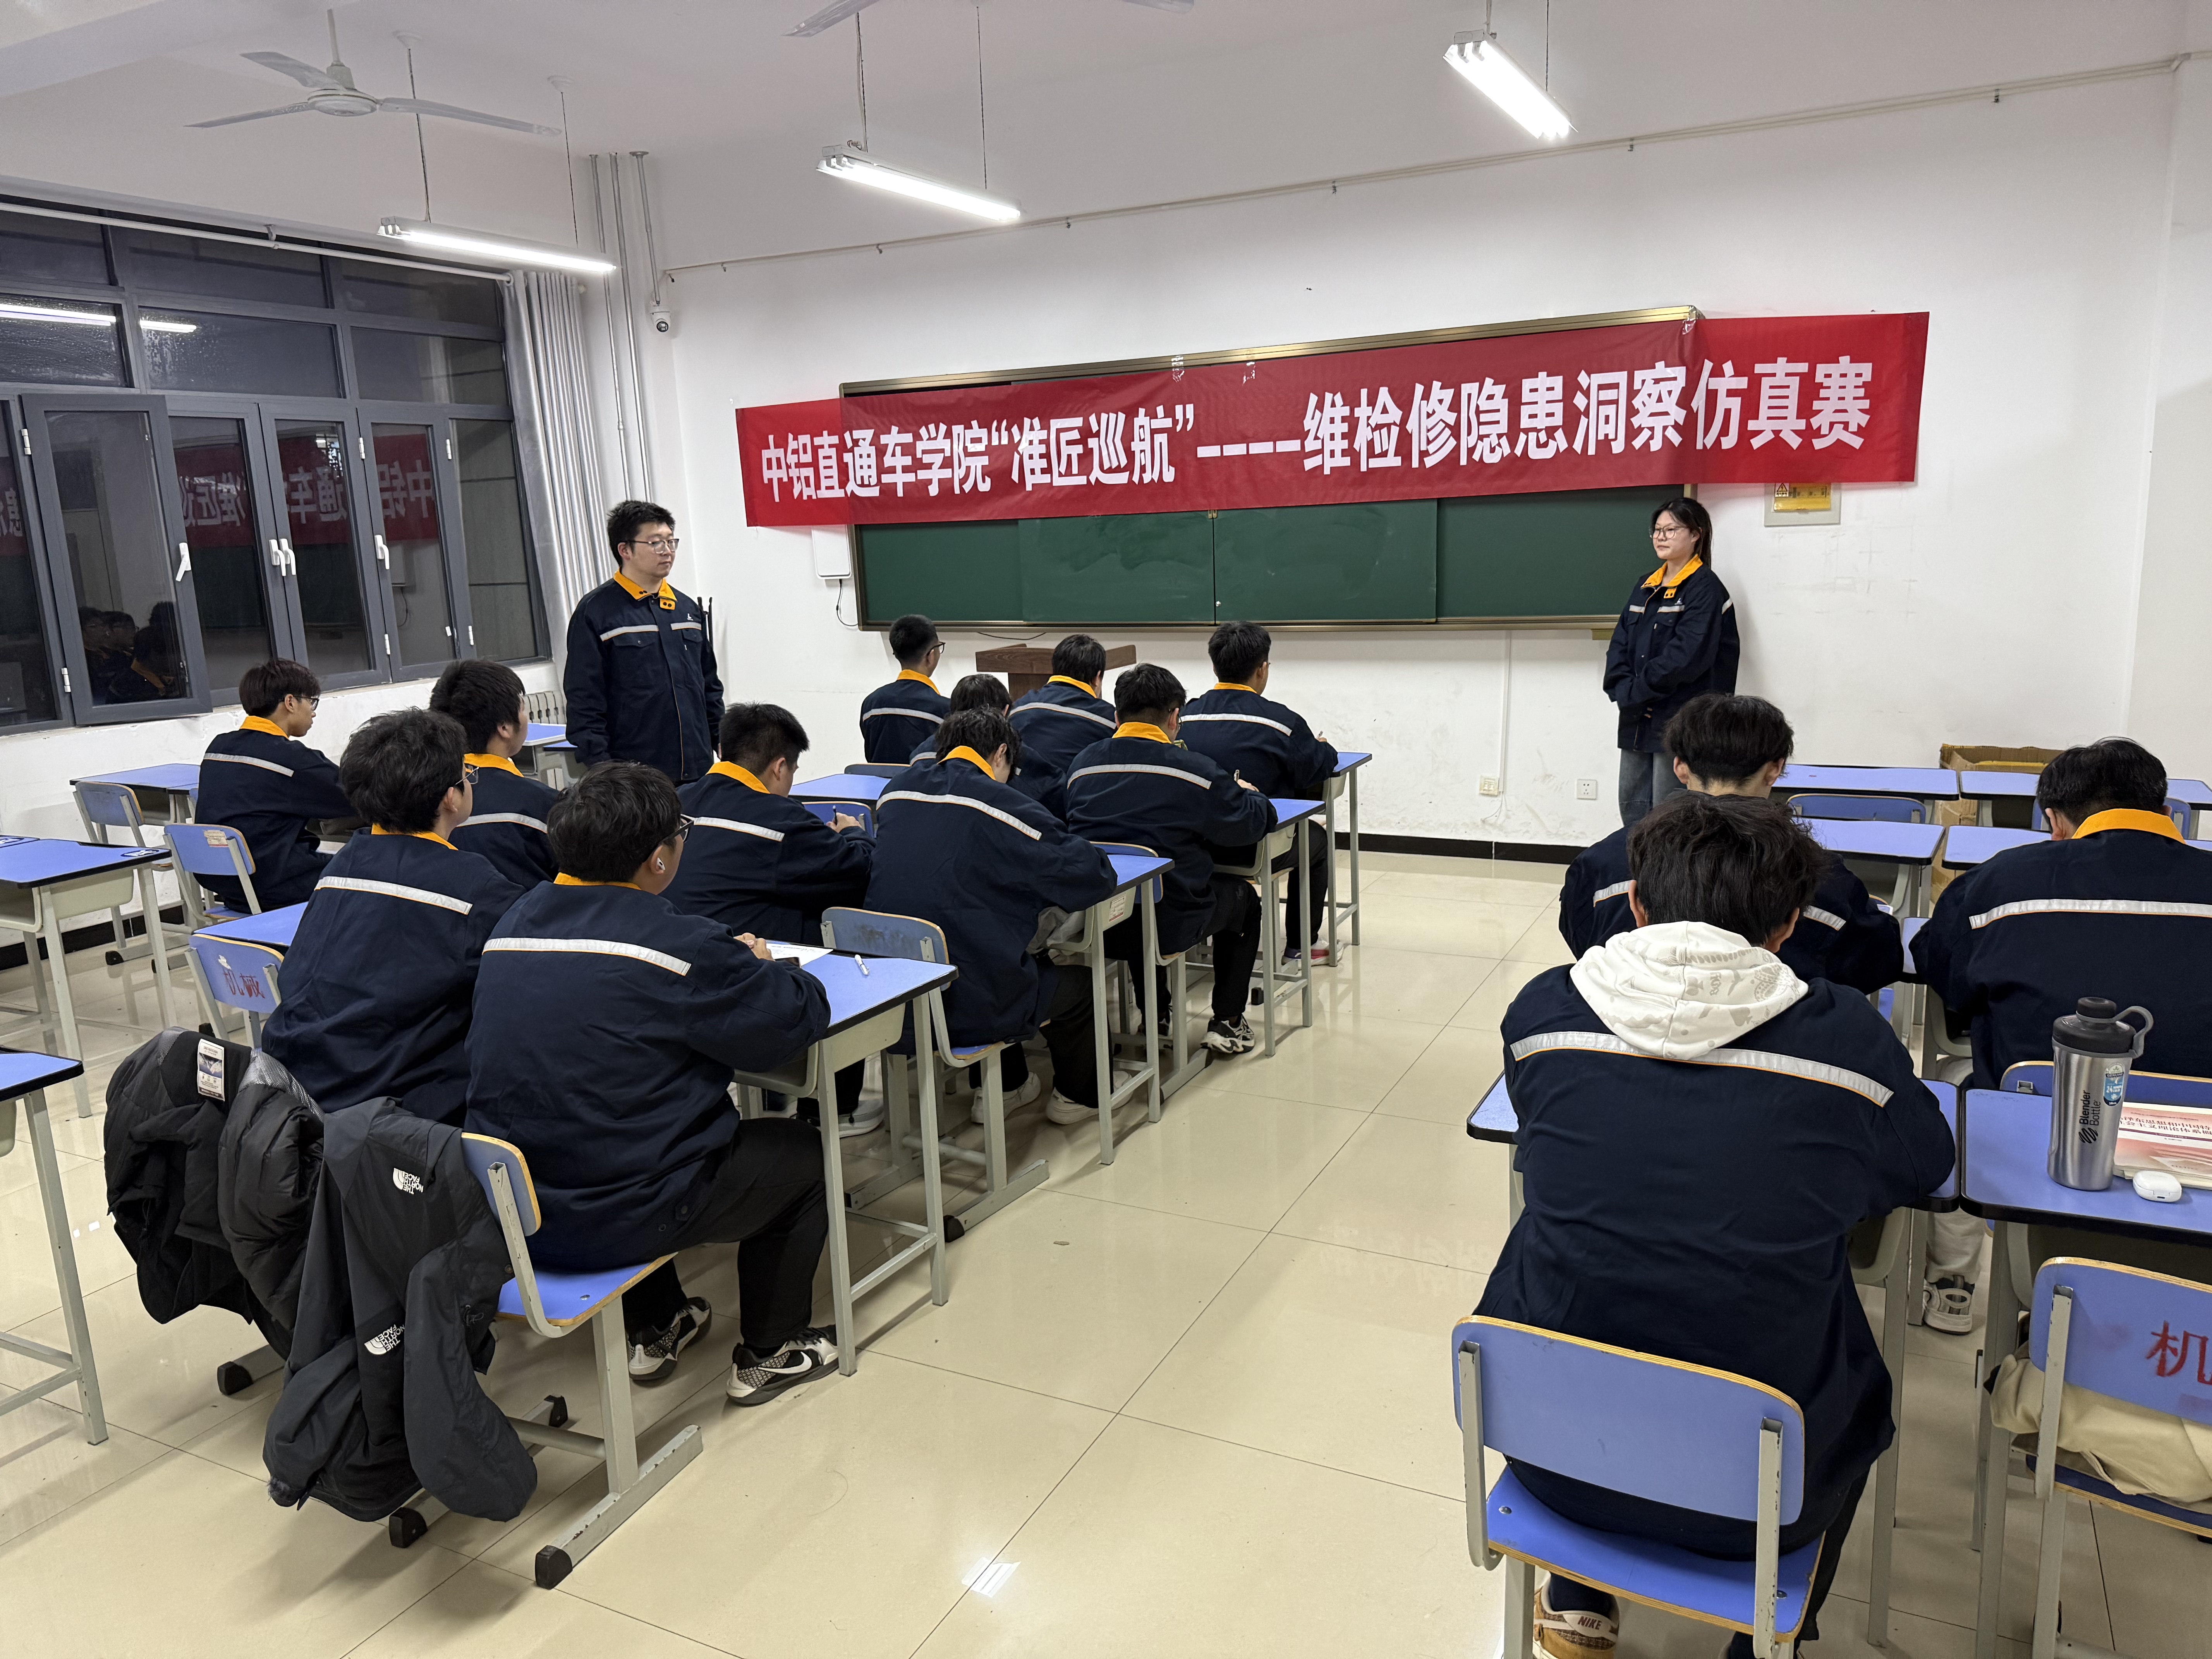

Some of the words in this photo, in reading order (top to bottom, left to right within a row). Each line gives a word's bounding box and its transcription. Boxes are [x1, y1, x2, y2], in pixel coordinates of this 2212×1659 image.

[2079, 1090, 2090, 1125] Blender
[2090, 1101, 2101, 1126] Bottle
[404, 1172, 420, 1183] FACE
[403, 1185, 414, 1194] THE
[404, 1178, 424, 1193] NORTH
[378, 1324, 397, 1341] FACE
[384, 1338, 400, 1352] THE
[2145, 1320, 2212, 1385] 机
[1577, 1616, 1602, 1630] NIKE
